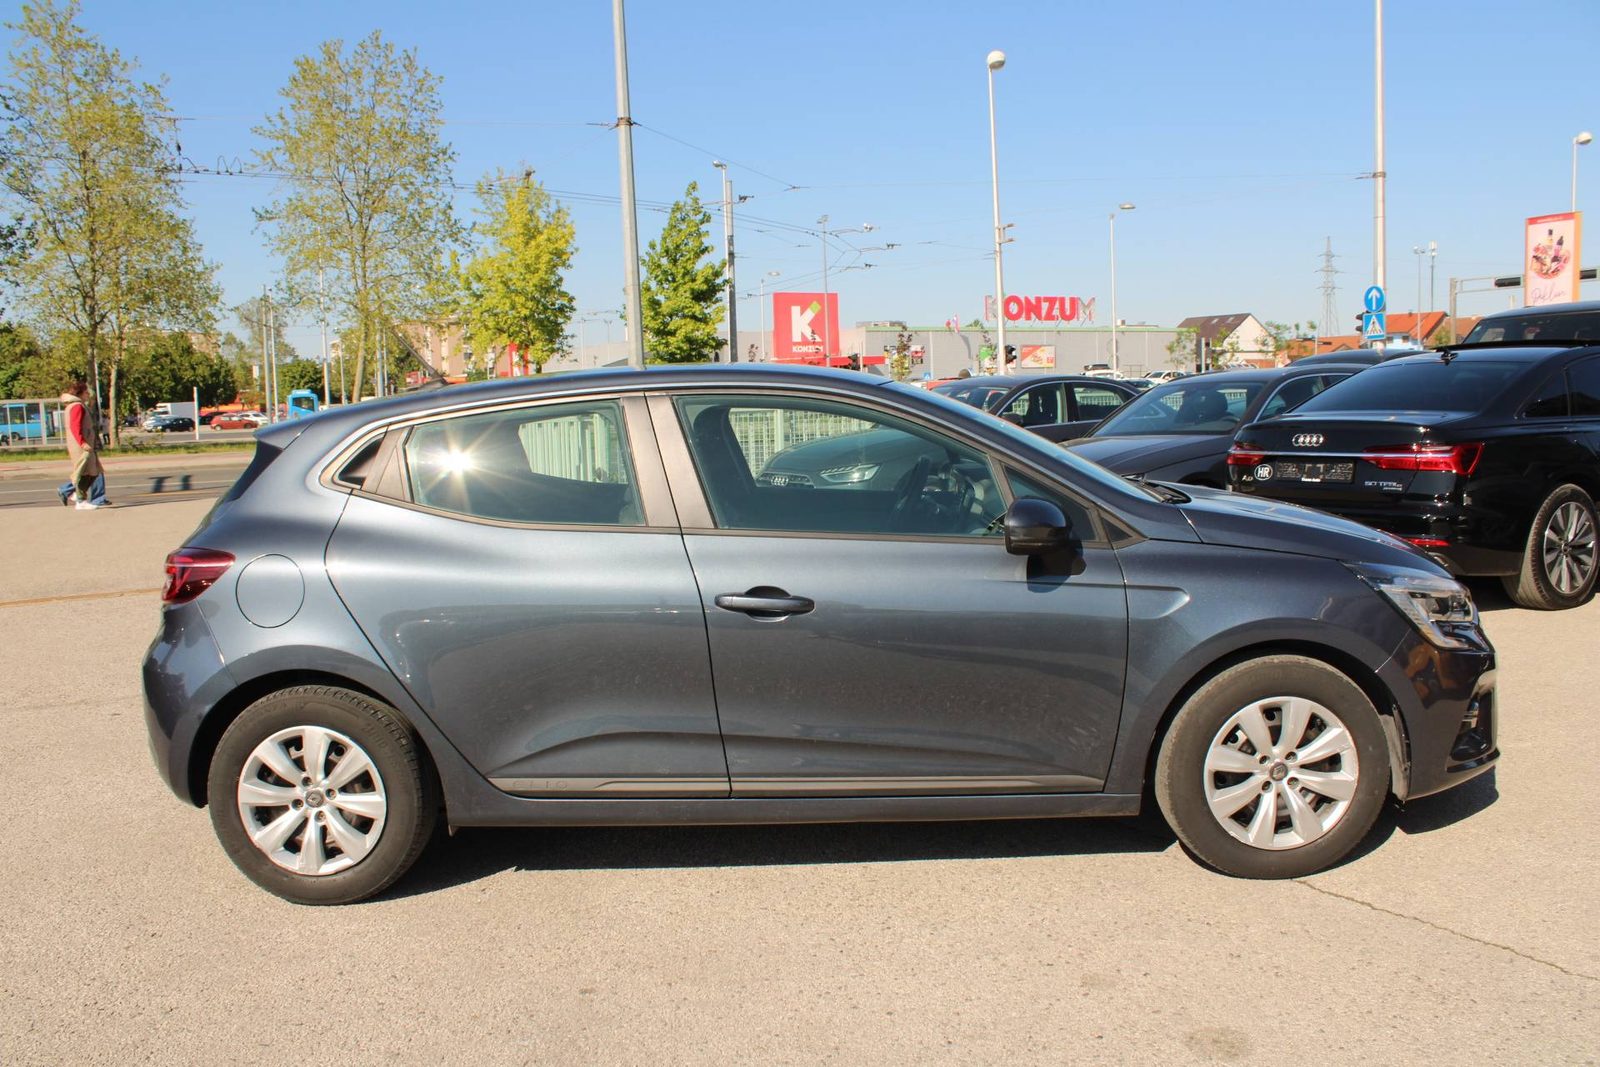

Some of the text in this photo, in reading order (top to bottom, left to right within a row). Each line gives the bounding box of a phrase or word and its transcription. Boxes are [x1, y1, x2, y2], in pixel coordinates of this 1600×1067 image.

[985, 295, 1095, 321] KONZUM
[791, 301, 822, 342] K
[1256, 466, 1270, 478] HR
[512, 780, 568, 790] CLIO
